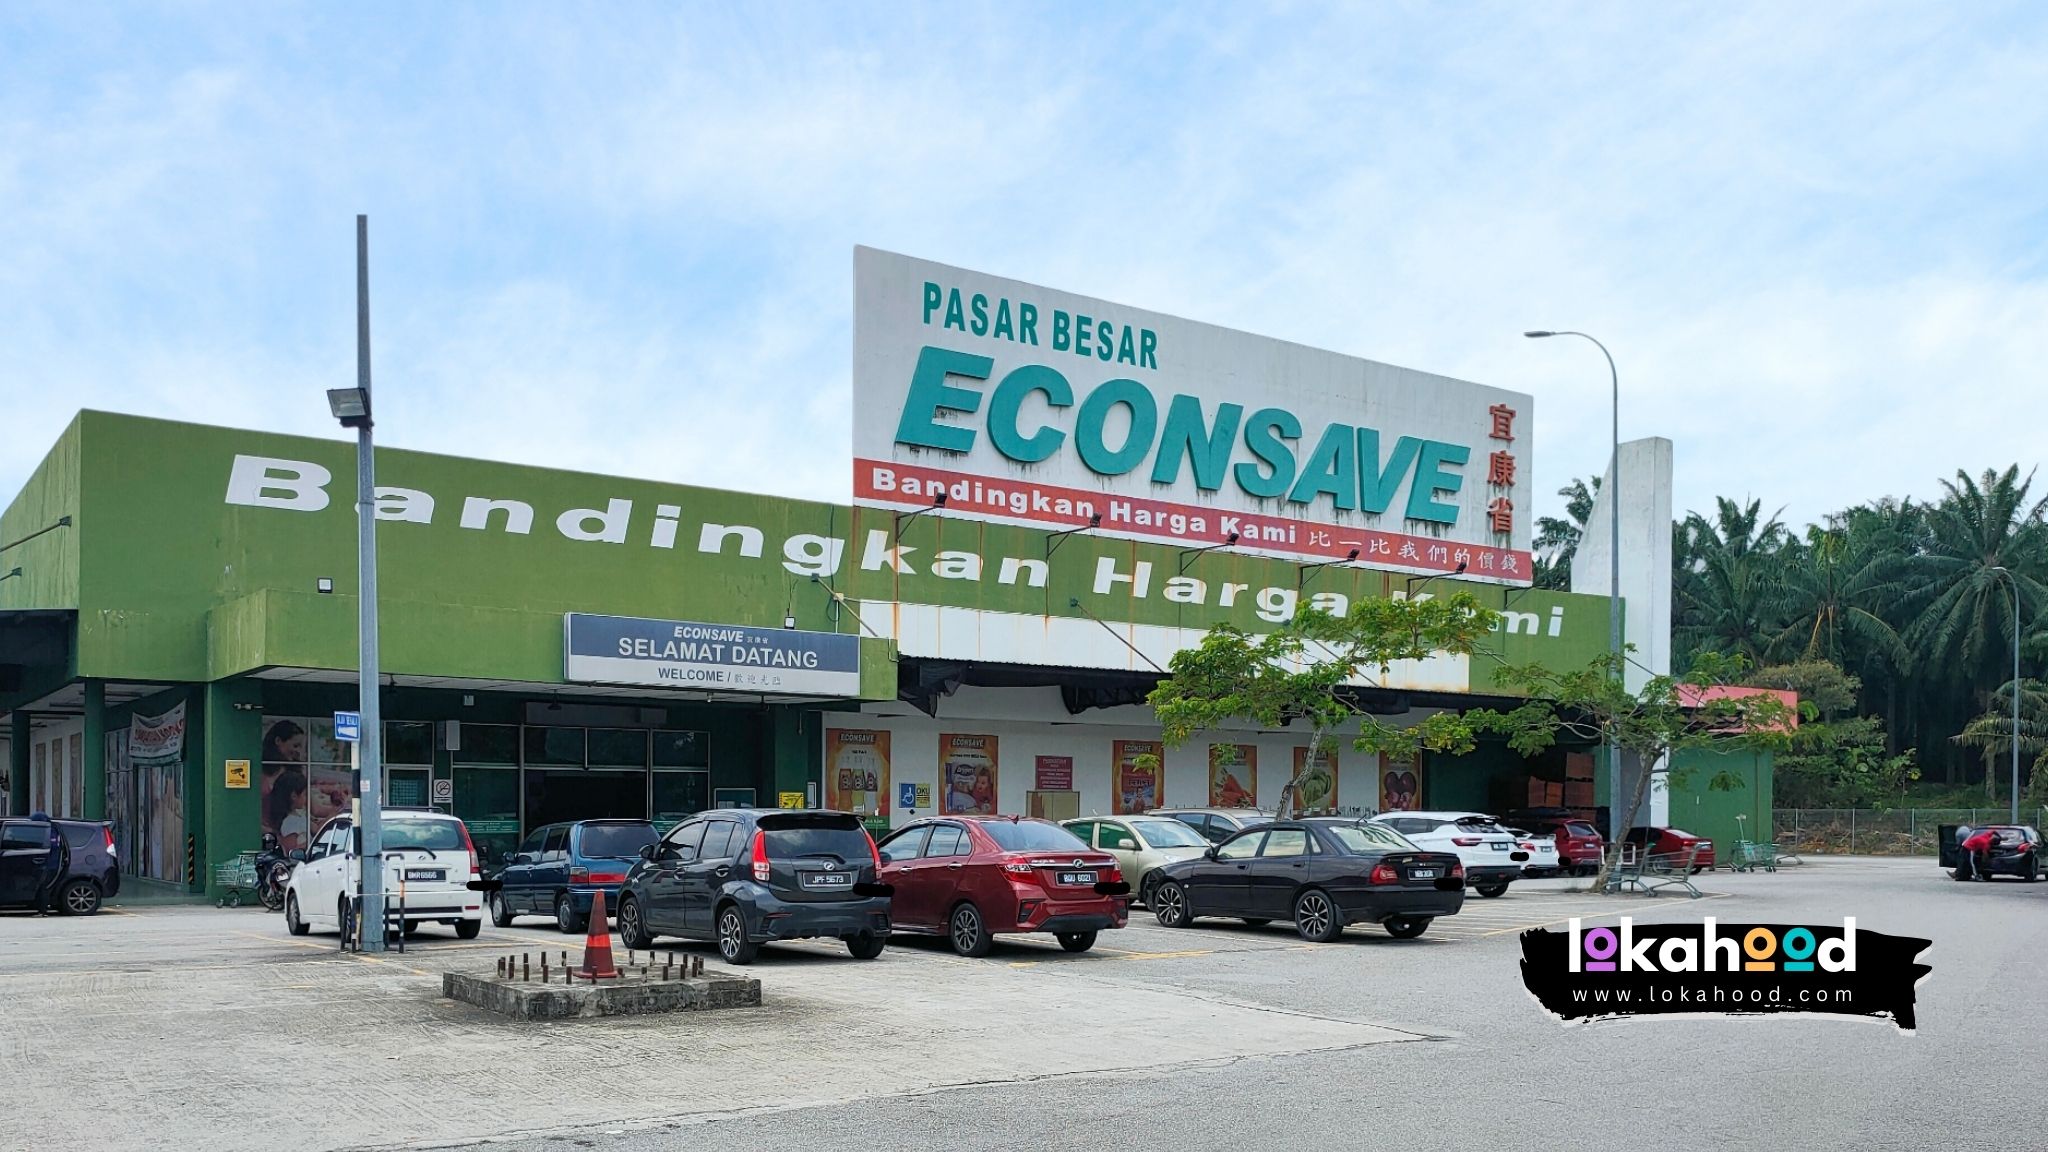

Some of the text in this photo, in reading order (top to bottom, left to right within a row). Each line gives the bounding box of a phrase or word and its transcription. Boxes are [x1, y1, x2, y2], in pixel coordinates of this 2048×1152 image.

[922, 281, 1159, 370] PASAR BESAR
[894, 345, 1472, 525] ECONSAVE
[1487, 403, 1517, 533] 宜康省
[225, 454, 1049, 588] Bandingkan
[1093, 556, 1349, 624] Harga
[873, 467, 1520, 574] Bandingkan Harga Kami 比一比我們的價錢
[618, 637, 819, 669] SELAMAT DATANG
[658, 667, 724, 682] WELCOME
[673, 626, 744, 643] ECONSAVE
